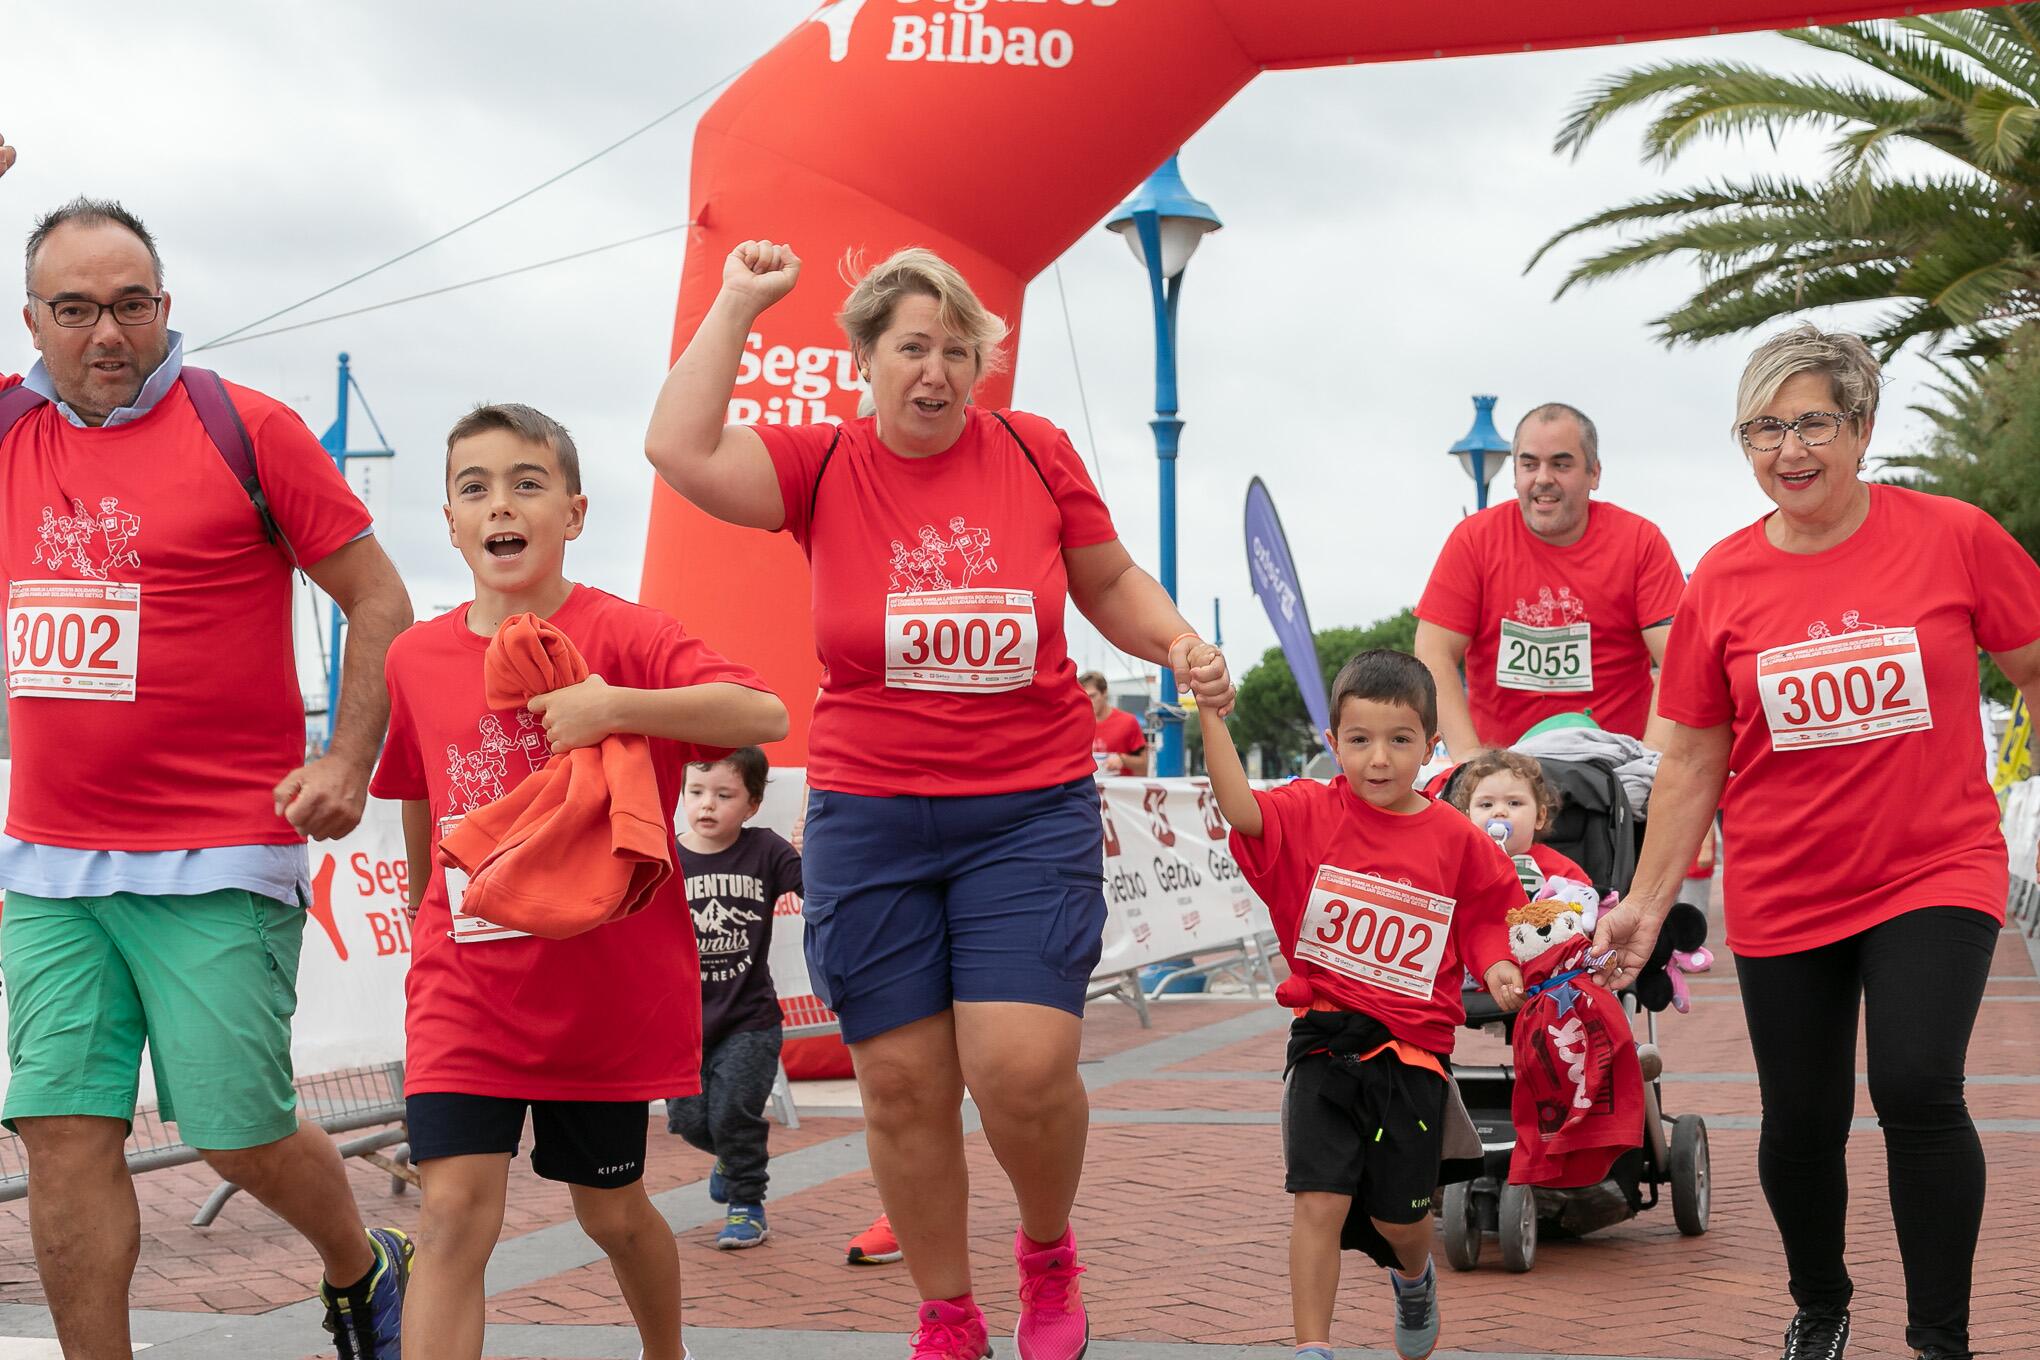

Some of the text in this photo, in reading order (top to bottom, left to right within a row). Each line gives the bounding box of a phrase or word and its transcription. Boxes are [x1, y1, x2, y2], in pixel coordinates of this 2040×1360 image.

[886, 12, 1074, 68] Bilbao
[13, 612, 120, 669] 3002
[902, 618, 1022, 667] 3002
[1508, 640, 1580, 676] 2055
[1778, 661, 1911, 726] 3002
[1316, 898, 1433, 973] 3002
[711, 955, 753, 983] READY
[597, 1161, 635, 1175] KIPSTA
